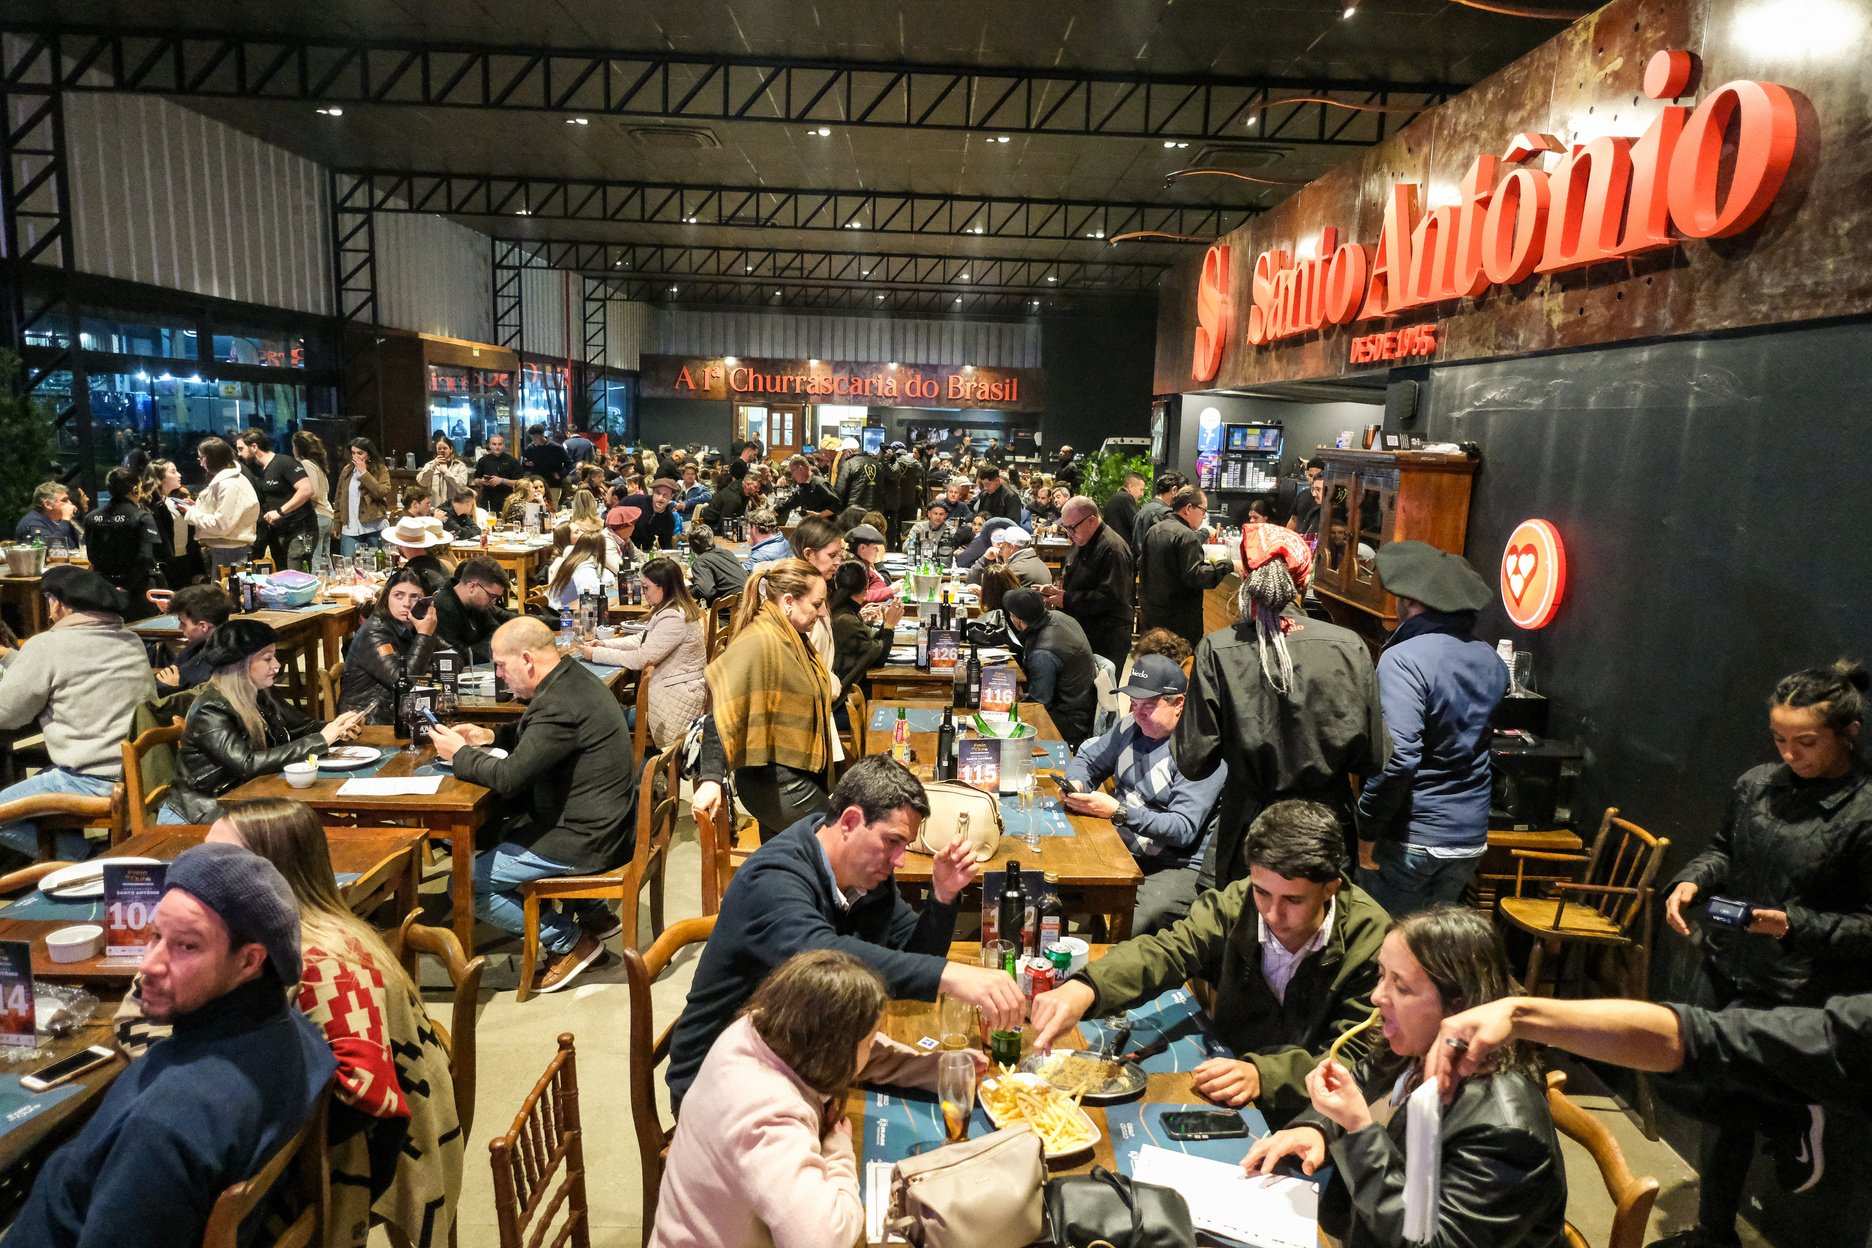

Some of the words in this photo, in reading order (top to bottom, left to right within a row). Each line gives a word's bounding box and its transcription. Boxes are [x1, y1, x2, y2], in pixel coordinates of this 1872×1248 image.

[1247, 226, 1367, 345] Santo
[1356, 49, 1798, 321] Antônio
[1350, 332, 1398, 364] DESDE
[674, 365, 695, 390] A
[729, 367, 898, 398] Churrascaria
[904, 374, 940, 399] do
[947, 375, 1019, 402] Brasil
[932, 647, 958, 661] 126
[984, 688, 1013, 704] 116
[962, 764, 997, 784] 115
[989, 906, 1035, 933] 12
